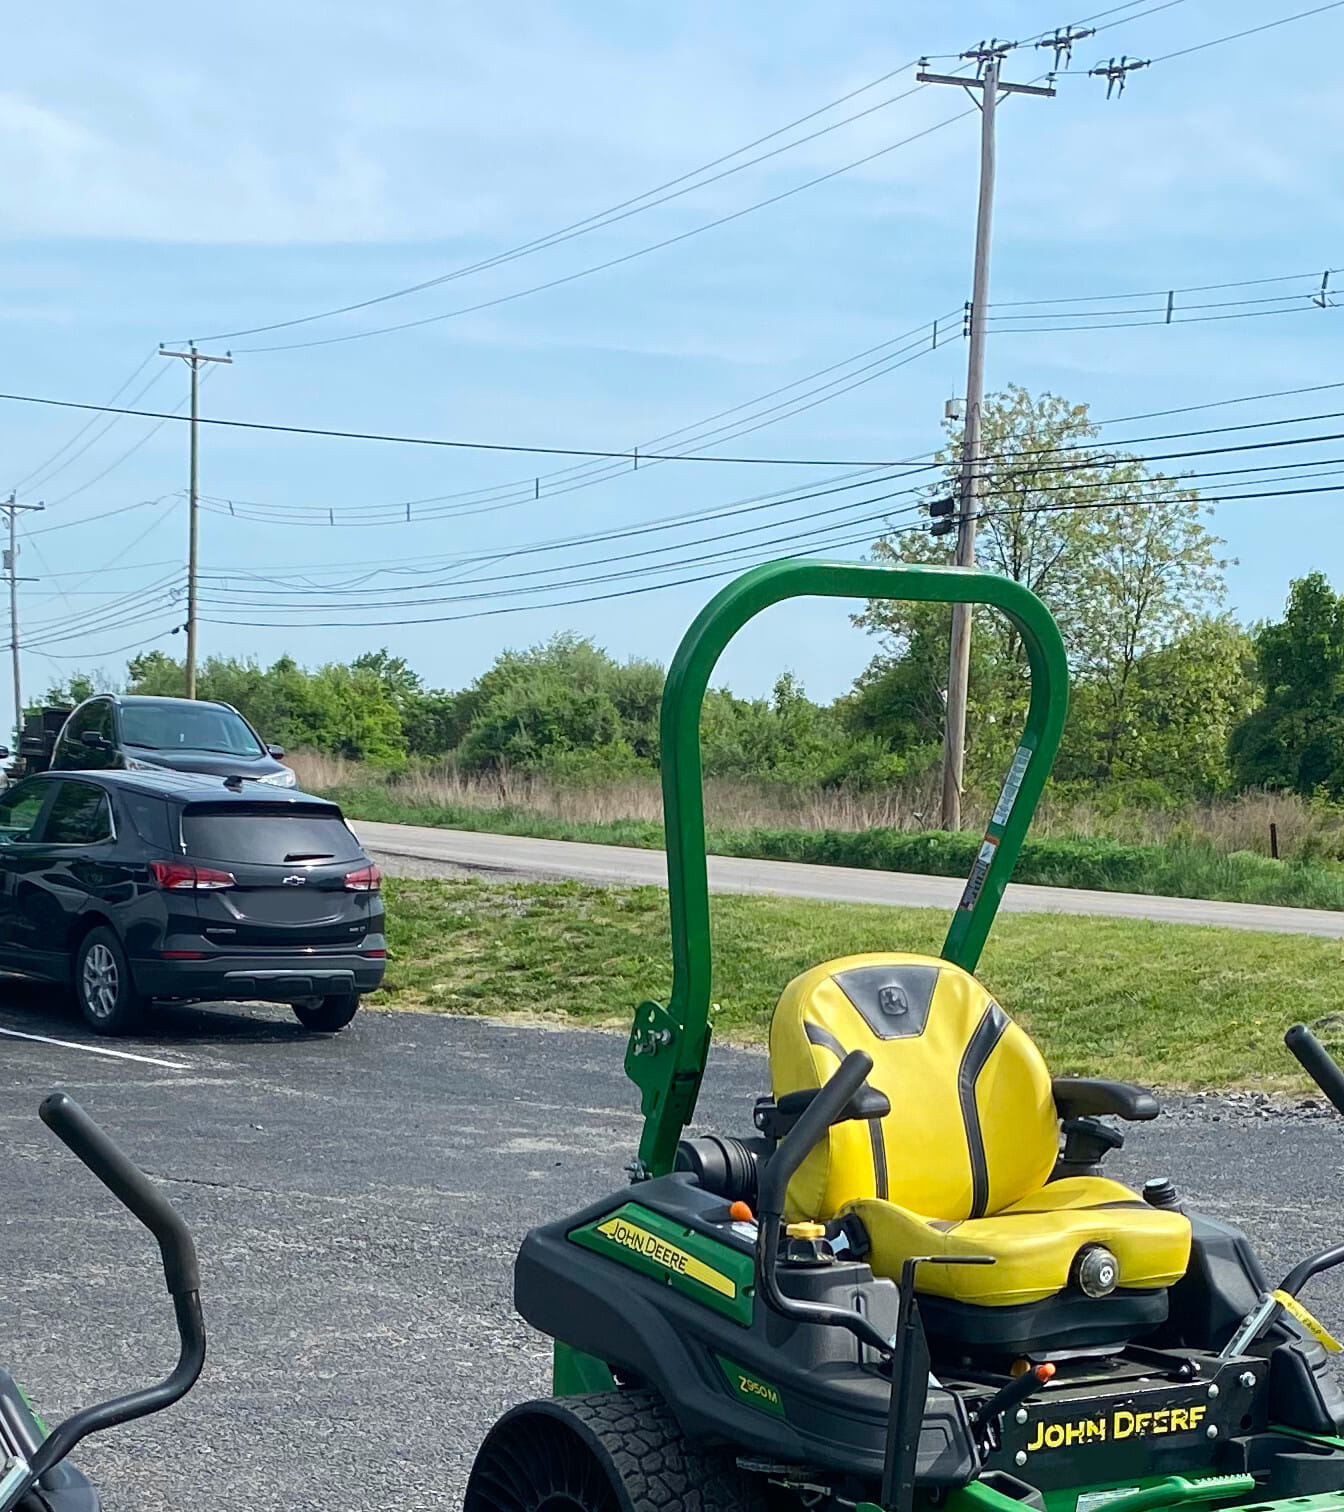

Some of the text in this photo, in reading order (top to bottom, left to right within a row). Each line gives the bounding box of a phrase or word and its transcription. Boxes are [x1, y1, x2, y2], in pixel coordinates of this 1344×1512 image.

[609, 1221, 689, 1272] JOHN DEERE
[1027, 1418, 1106, 1451] JOHN
